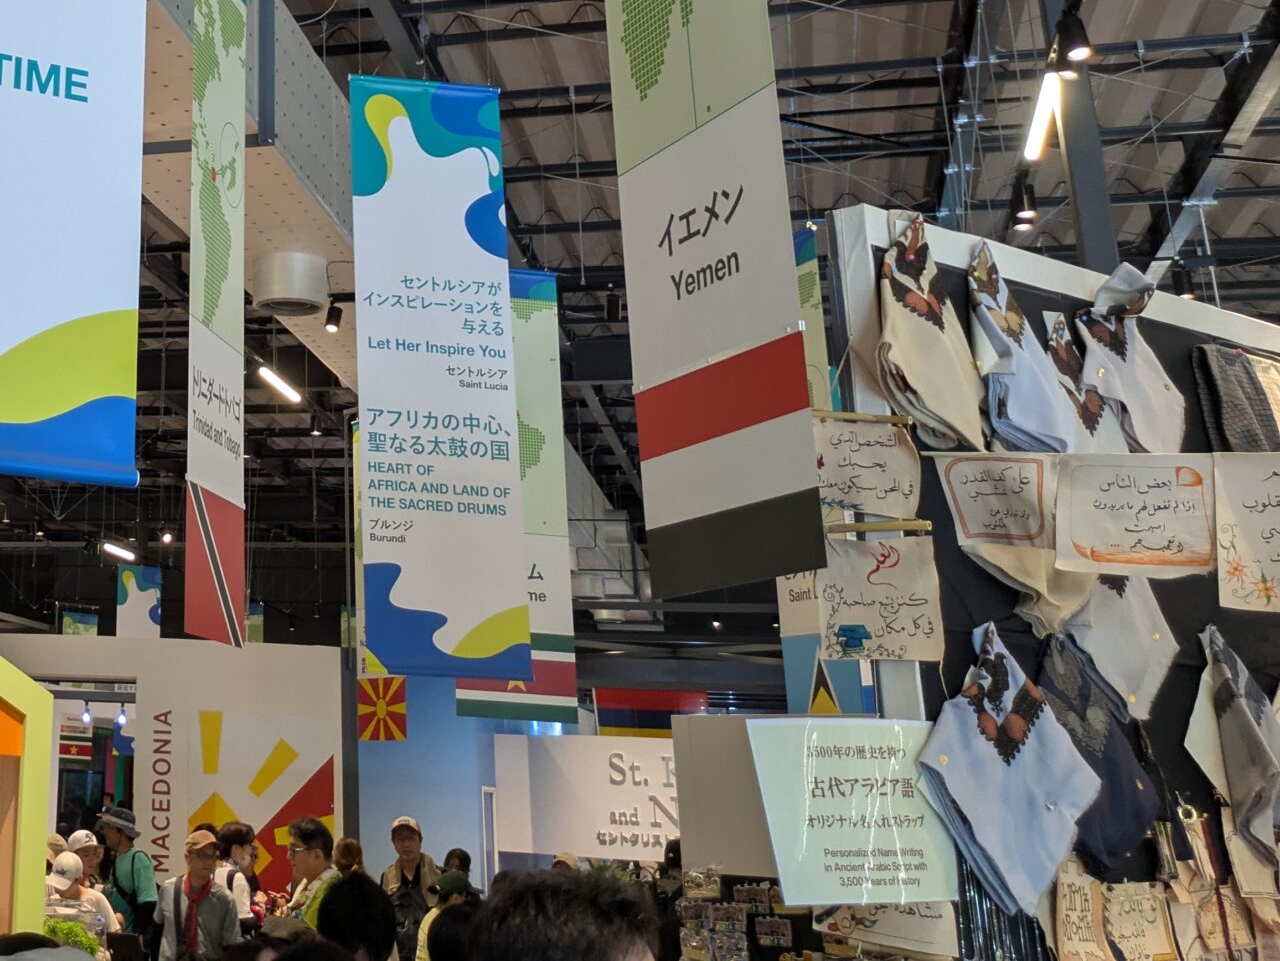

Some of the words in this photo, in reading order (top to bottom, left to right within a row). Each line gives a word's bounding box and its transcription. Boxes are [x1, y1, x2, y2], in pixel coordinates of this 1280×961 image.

[658, 184, 744, 257] イエメン
[400, 274, 502, 297] セントルシアが
[670, 251, 740, 301] Yemen
[363, 291, 503, 317] インスピレーションを
[461, 318, 505, 337] 与える
[367, 336, 391, 350] Let
[395, 338, 421, 353] Her
[425, 340, 475, 358] Inspire
[478, 344, 507, 359] You
[445, 365, 508, 380] セントルシア
[459, 379, 482, 390] Saint
[483, 381, 509, 391] Lucia
[366, 408, 512, 437] アフリカの中心、
[192, 409, 213, 441] Trinidad
[213, 425, 223, 447] and
[223, 429, 241, 461] Tobago
[367, 432, 510, 462] 聖なる太鼓の国
[367, 462, 413, 476] HEART
[416, 464, 435, 476] OF
[367, 478, 417, 493] AFRICA
[420, 481, 449, 494] AND
[452, 483, 490, 497] LAND
[492, 486, 511, 499] OF
[368, 496, 395, 509] THE
[398, 498, 454, 512] SACRED
[457, 502, 507, 516] DRUMS
[368, 517, 414, 531] ブルンジ
[369, 532, 407, 543] Burundi
[788, 588, 812, 603] Saint
[608, 752, 649, 787] St.
[151, 710, 173, 873] MACEDONIA
[808, 777, 914, 798] 古代アラビア語
[609, 807, 640, 826] and
[834, 862, 866, 872] Ancient
[913, 862, 928, 872] with
[839, 877, 864, 888] 3,500
[888, 876, 897, 885] of
